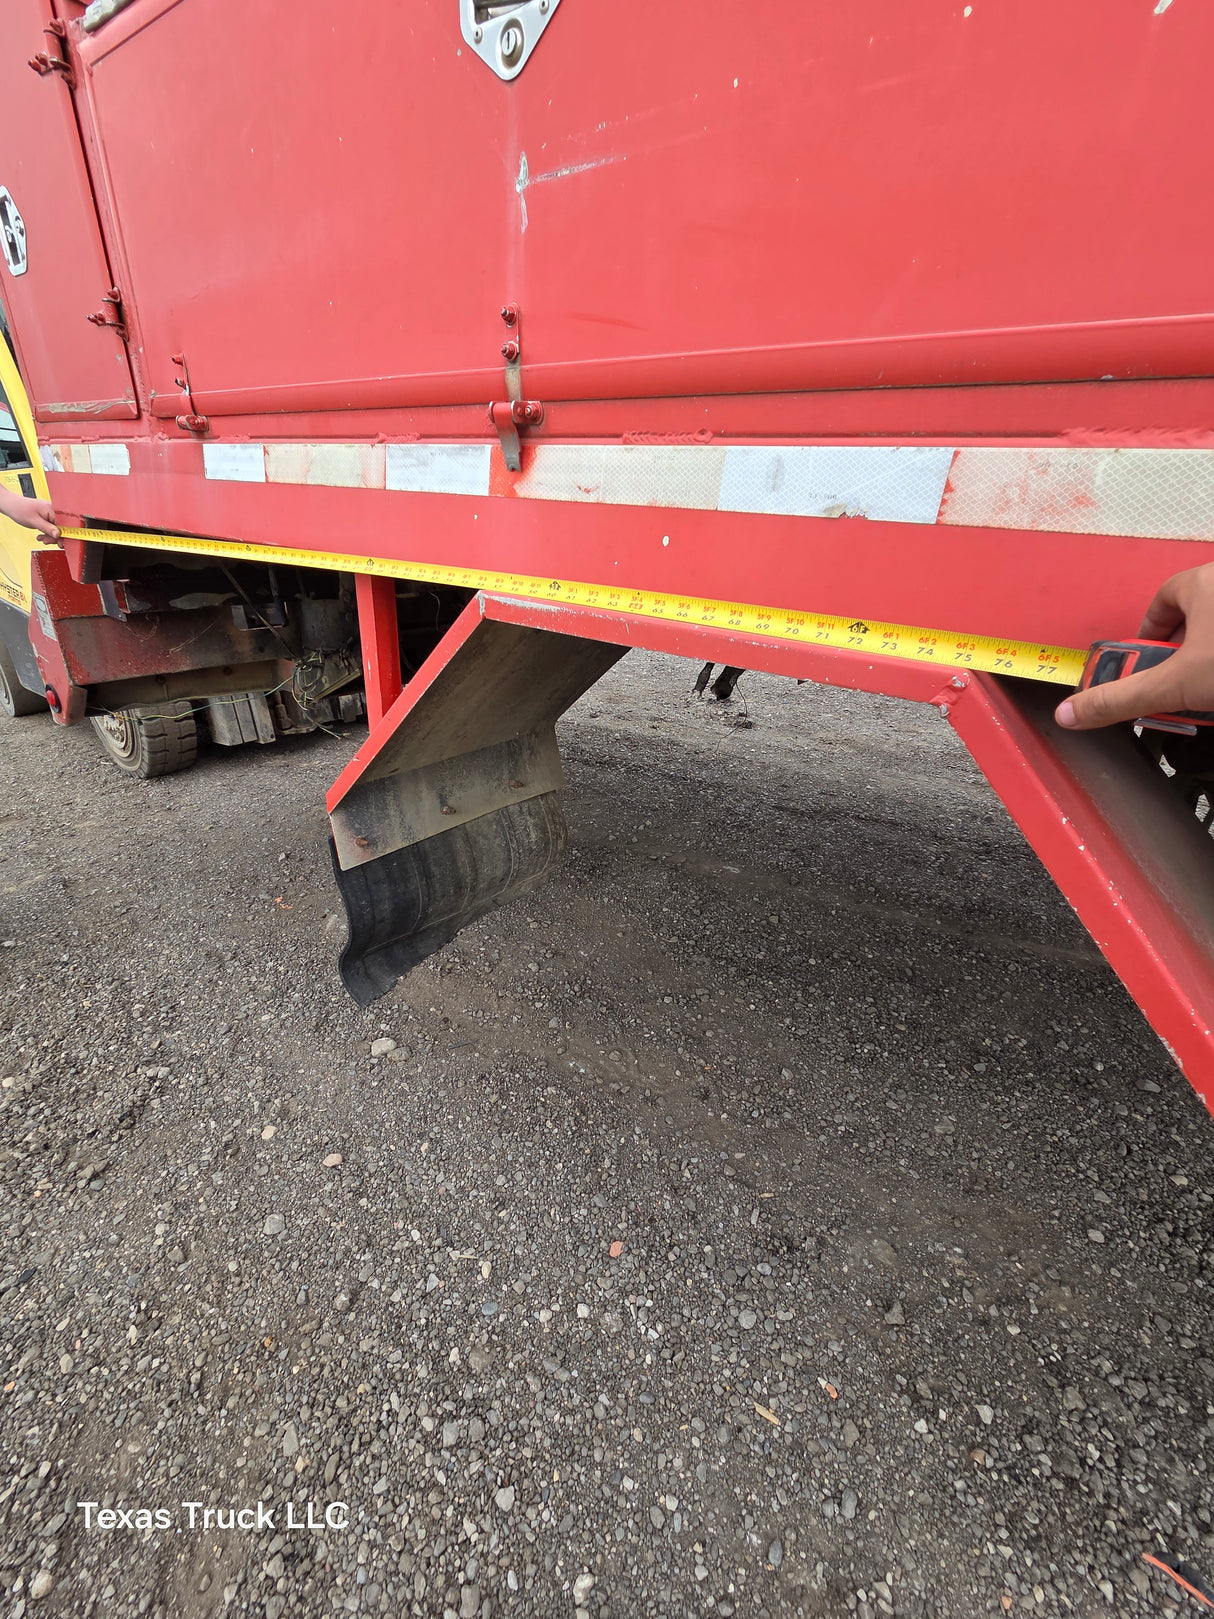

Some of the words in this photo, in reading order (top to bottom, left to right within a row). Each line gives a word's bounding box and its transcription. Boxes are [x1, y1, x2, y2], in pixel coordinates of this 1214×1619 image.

[784, 627, 799, 635] 70
[815, 631, 829, 639] 71
[847, 636, 863, 645] 72
[881, 641, 898, 650] 73
[916, 647, 934, 656] 74
[954, 652, 973, 662] 75
[994, 658, 1013, 668] 76
[1036, 664, 1058, 674] 77
